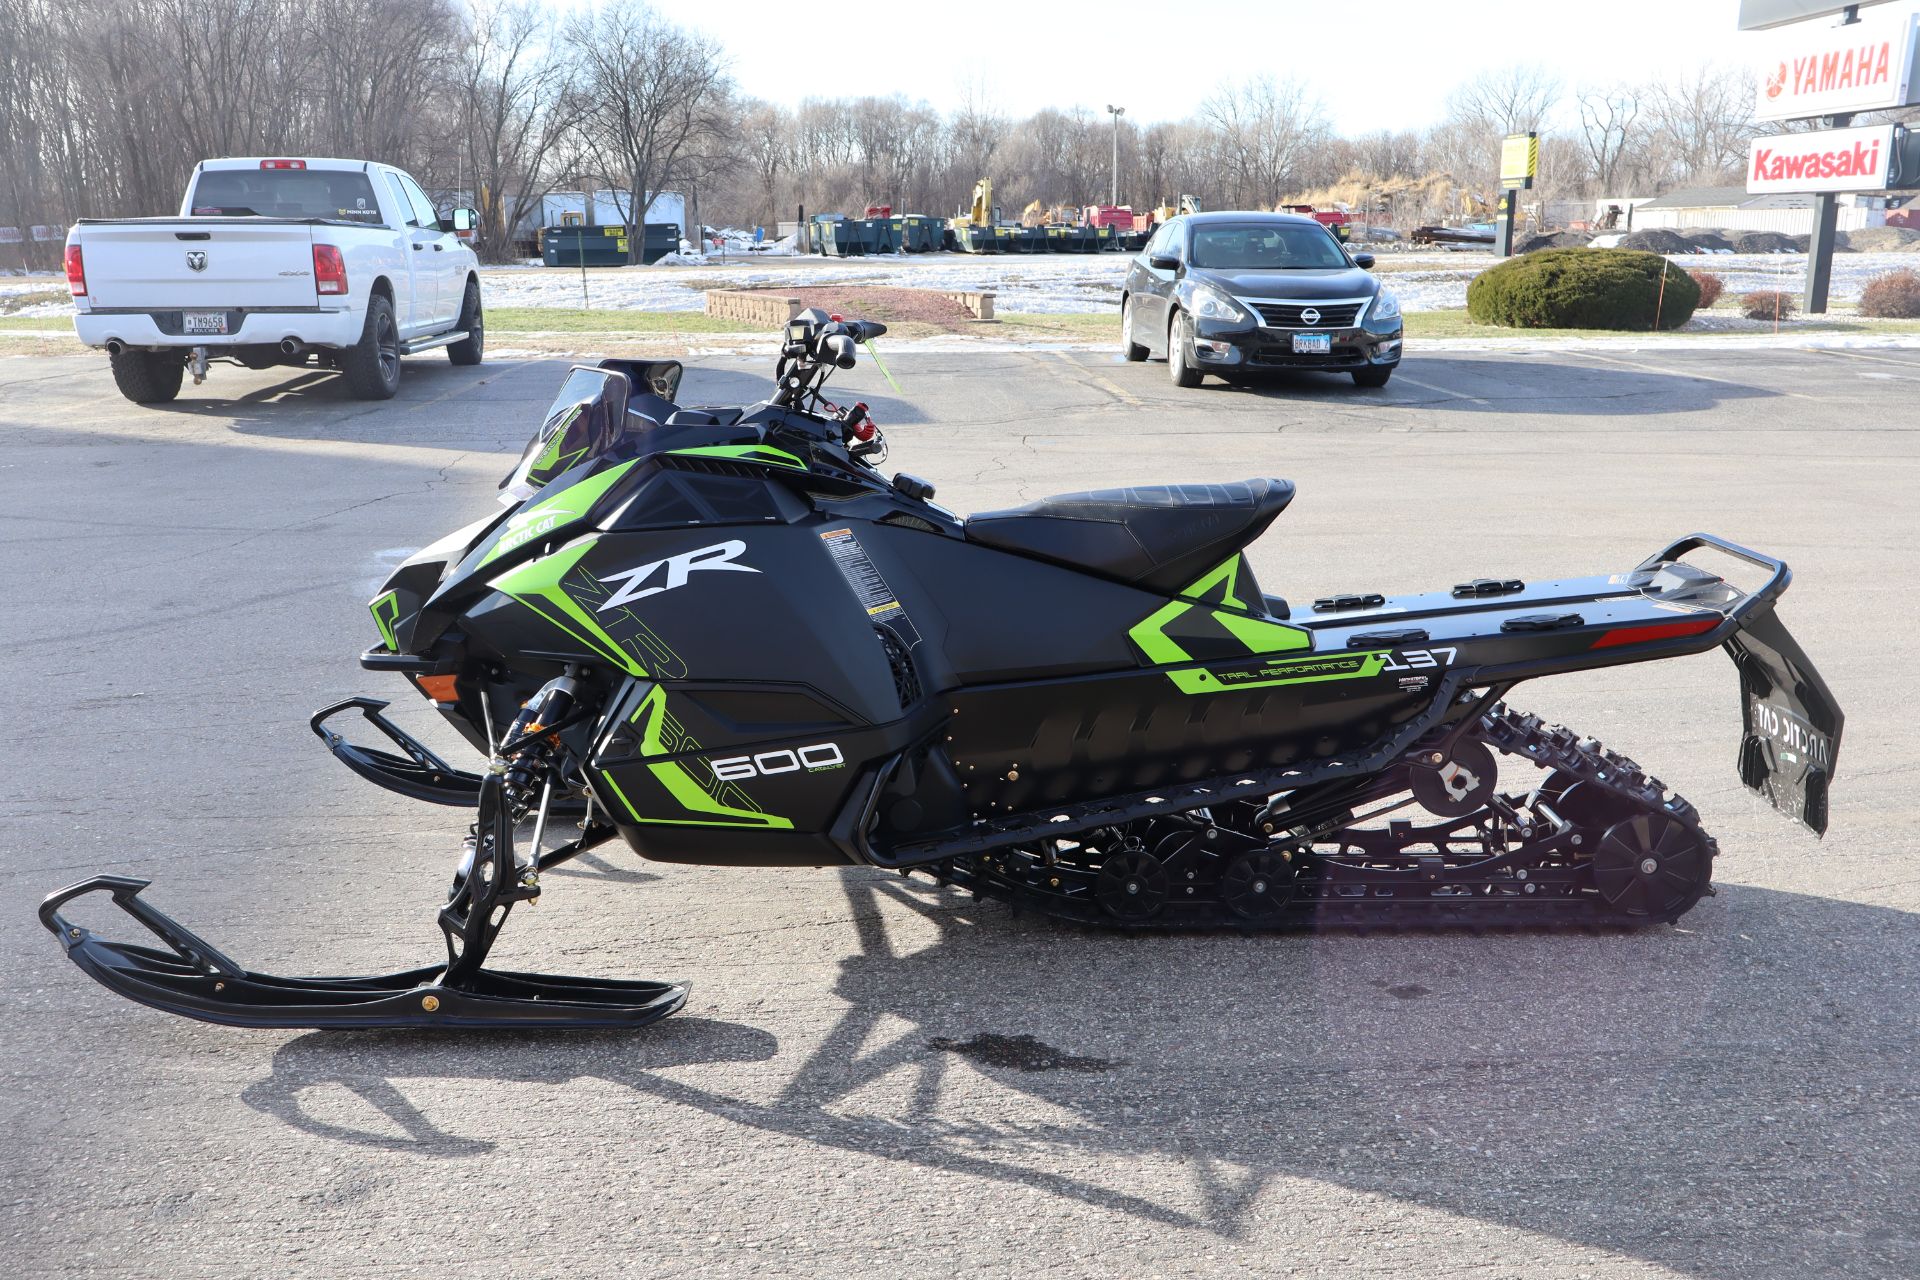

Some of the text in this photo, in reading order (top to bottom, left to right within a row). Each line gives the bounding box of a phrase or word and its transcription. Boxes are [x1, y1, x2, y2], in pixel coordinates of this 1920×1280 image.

[1793, 41, 1890, 95] YAMAHA
[1753, 139, 1880, 181] Kawasaki
[536, 515, 556, 534] CAT
[596, 540, 764, 613] ZR
[1218, 660, 1360, 681] TRAIL PERFORMANCE
[1379, 647, 1457, 671] 137
[710, 742, 844, 781] 600
[808, 763, 846, 773] CATALYST
